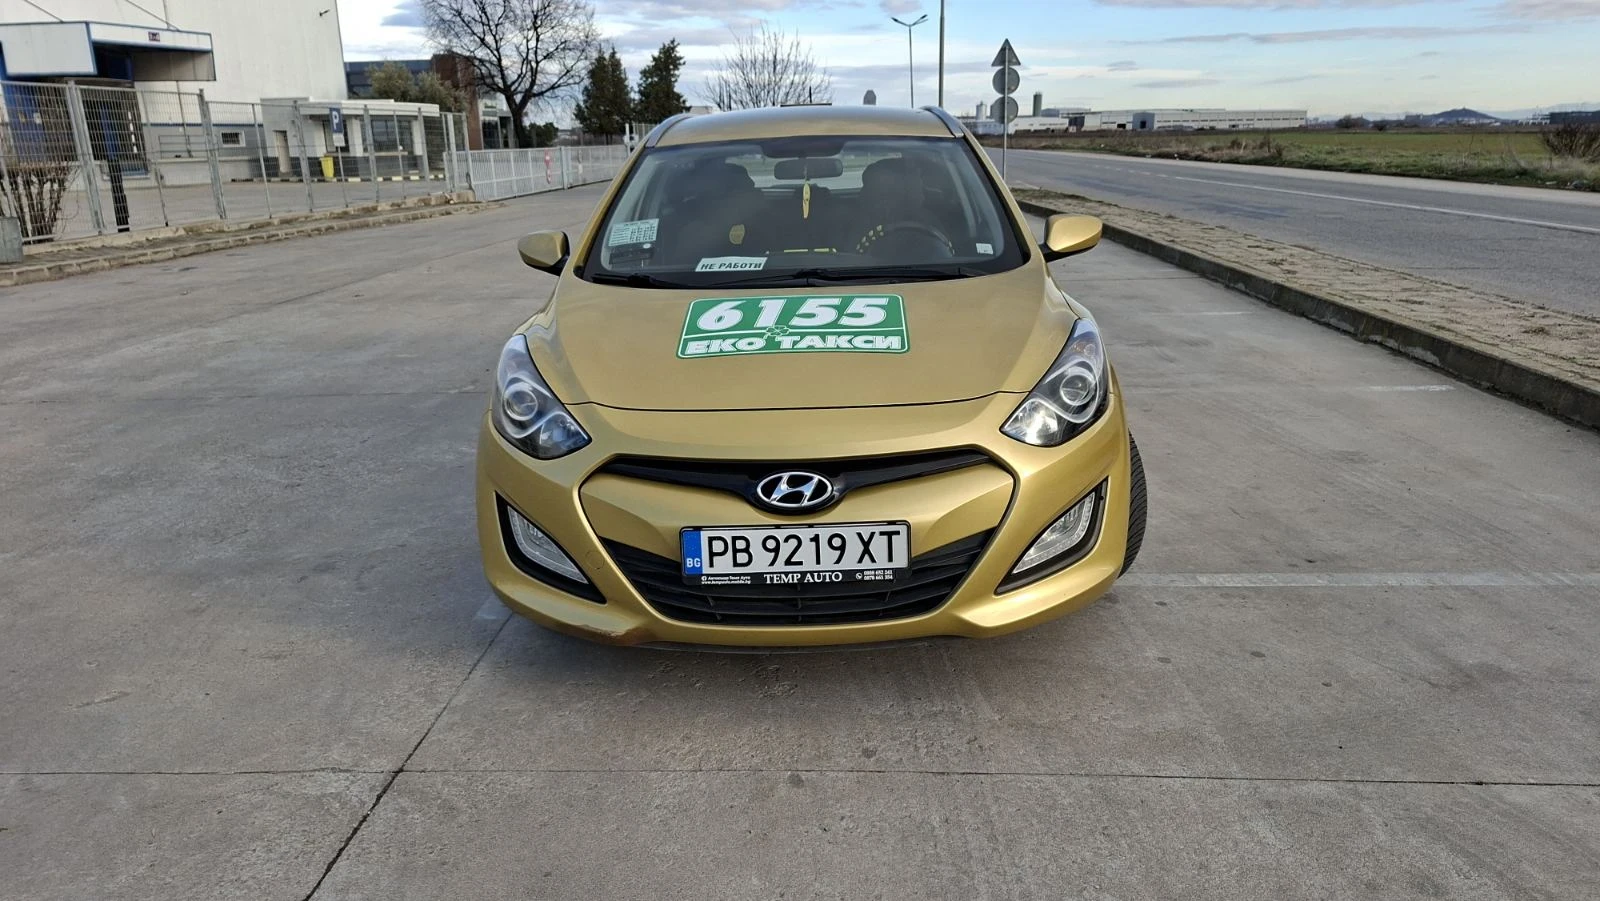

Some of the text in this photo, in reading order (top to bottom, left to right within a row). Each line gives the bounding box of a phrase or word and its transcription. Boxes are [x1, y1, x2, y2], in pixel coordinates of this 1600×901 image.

[332, 111, 339, 130] P
[697, 297, 889, 330] 6155
[684, 335, 902, 355] ЕКО ТАКСИ
[707, 530, 901, 568] PB 9219 XT
[686, 558, 701, 568] BG
[764, 571, 843, 584] TEMP AUTO
